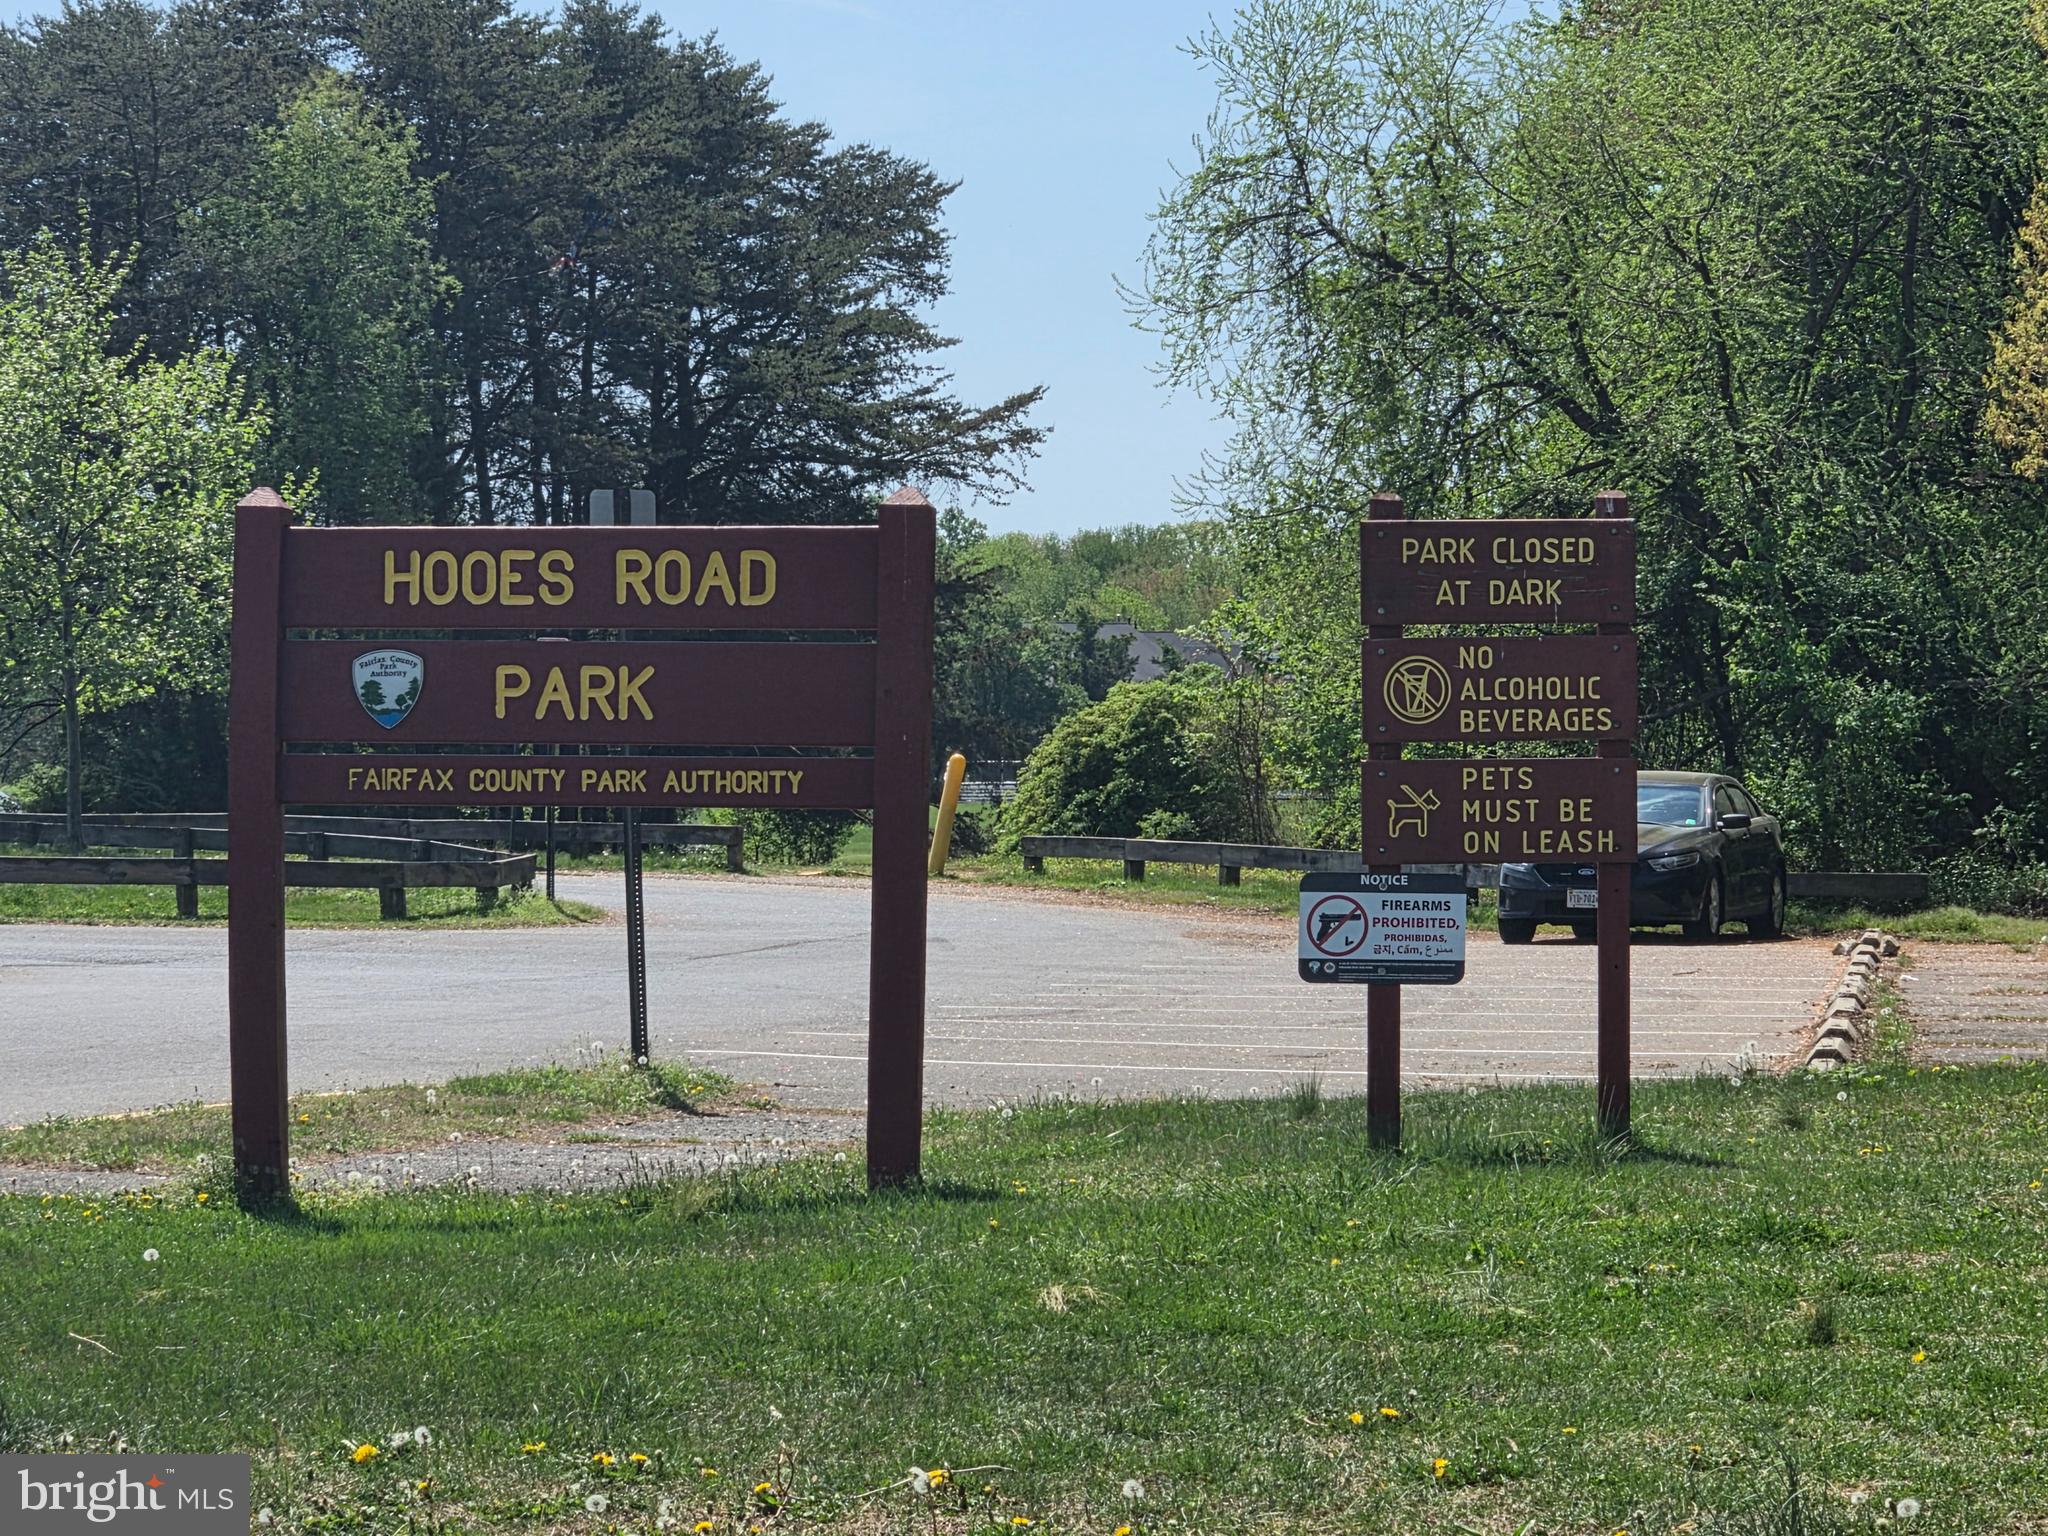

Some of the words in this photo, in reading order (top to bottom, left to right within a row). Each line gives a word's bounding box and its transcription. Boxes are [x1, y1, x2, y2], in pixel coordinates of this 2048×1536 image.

[1402, 537, 1476, 564] PARK
[1492, 537, 1595, 564] CLOSED
[384, 549, 575, 606] HOOES
[615, 549, 777, 606] ROAD
[1436, 580, 1471, 606] AT
[1489, 579, 1562, 606] DARK
[359, 656, 386, 669] Fairfax
[389, 655, 418, 669] County
[1459, 646, 1493, 670] NO
[494, 664, 655, 721] PARK
[1460, 676, 1601, 701] ALCOHOLIC
[1460, 707, 1612, 733] BEVERAGES
[348, 767, 454, 792] FAIRFAX
[469, 768, 566, 792] COUNTY
[581, 768, 647, 793] PARK
[663, 769, 804, 795] AUTHORITY
[1462, 766, 1534, 791] PETS
[1462, 799, 1540, 823] MUST
[1559, 798, 1593, 822] BE
[1463, 830, 1499, 855] ON
[1522, 829, 1614, 854] LEASH
[1360, 874, 1409, 886] NOTICE
[1381, 900, 1451, 911] FIREARMS
[1372, 917, 1460, 930] PROHIBITED,
[1384, 933, 1447, 943] PROHIBIDAS,
